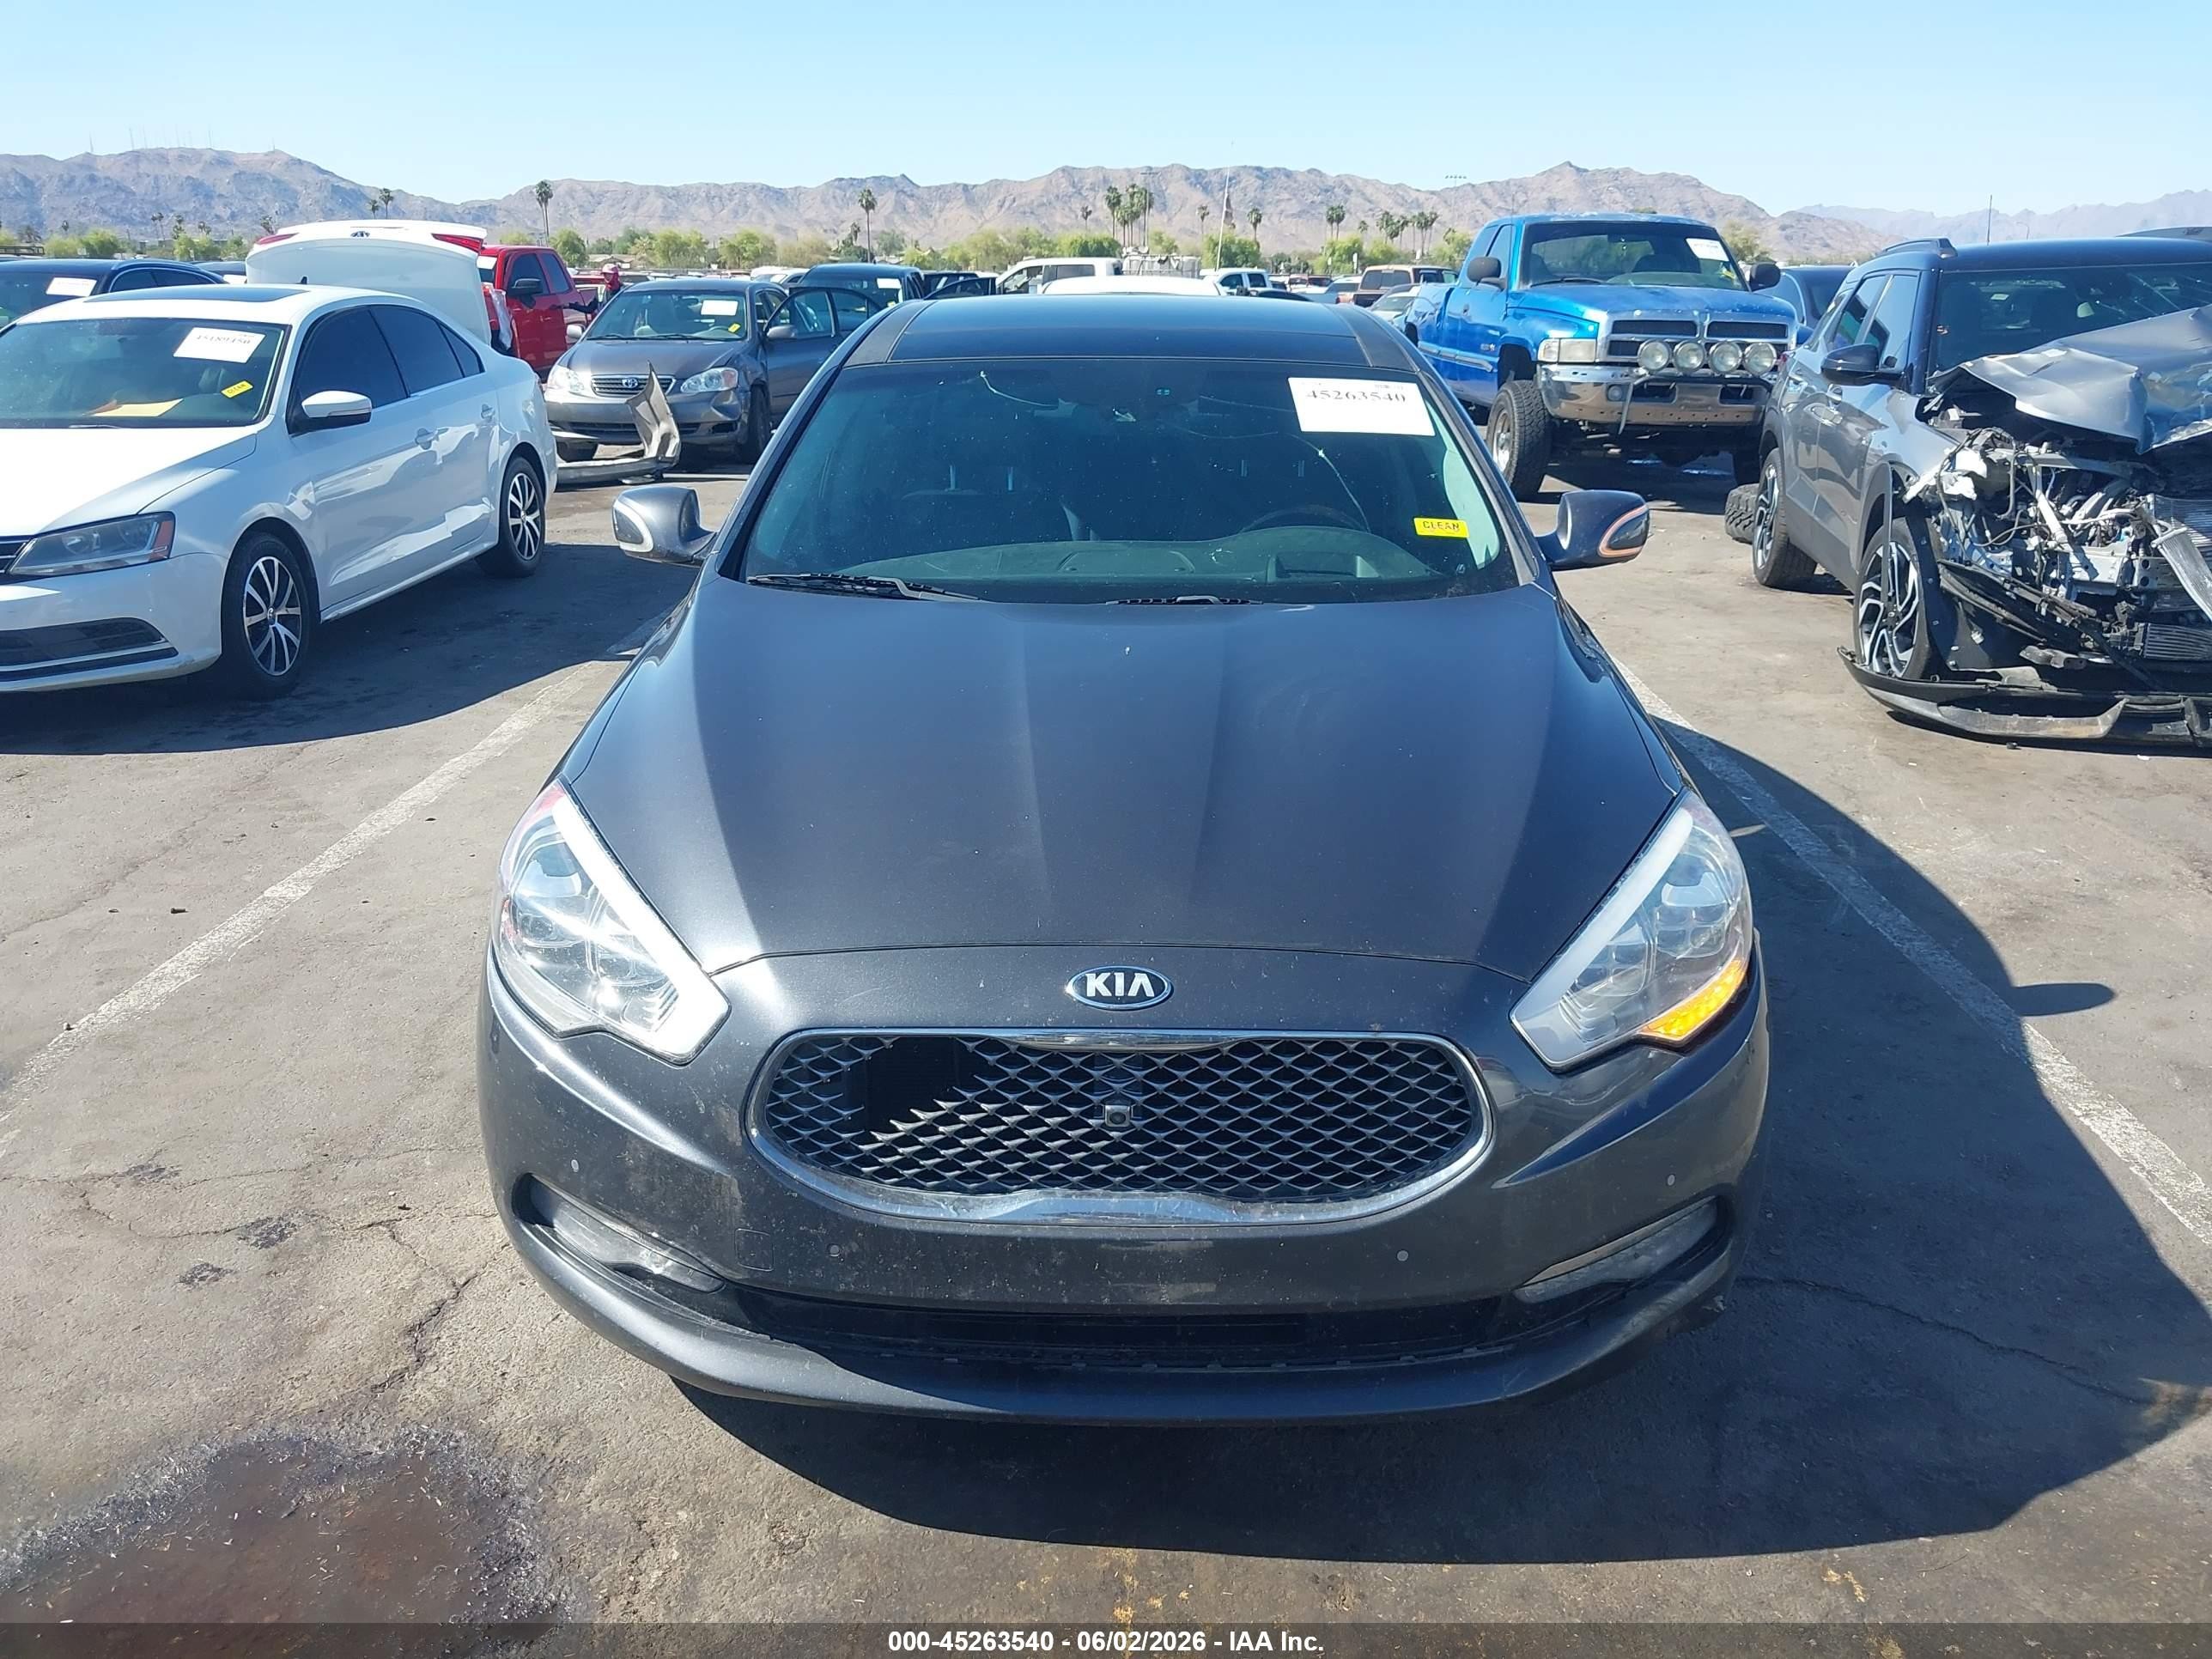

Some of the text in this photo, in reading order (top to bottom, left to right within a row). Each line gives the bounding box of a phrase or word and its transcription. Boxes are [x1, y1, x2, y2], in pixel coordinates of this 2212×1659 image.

[1305, 389, 1407, 403] 45263540
[1422, 520, 1460, 530] CLEAN
[1085, 972, 1155, 998] KIA
